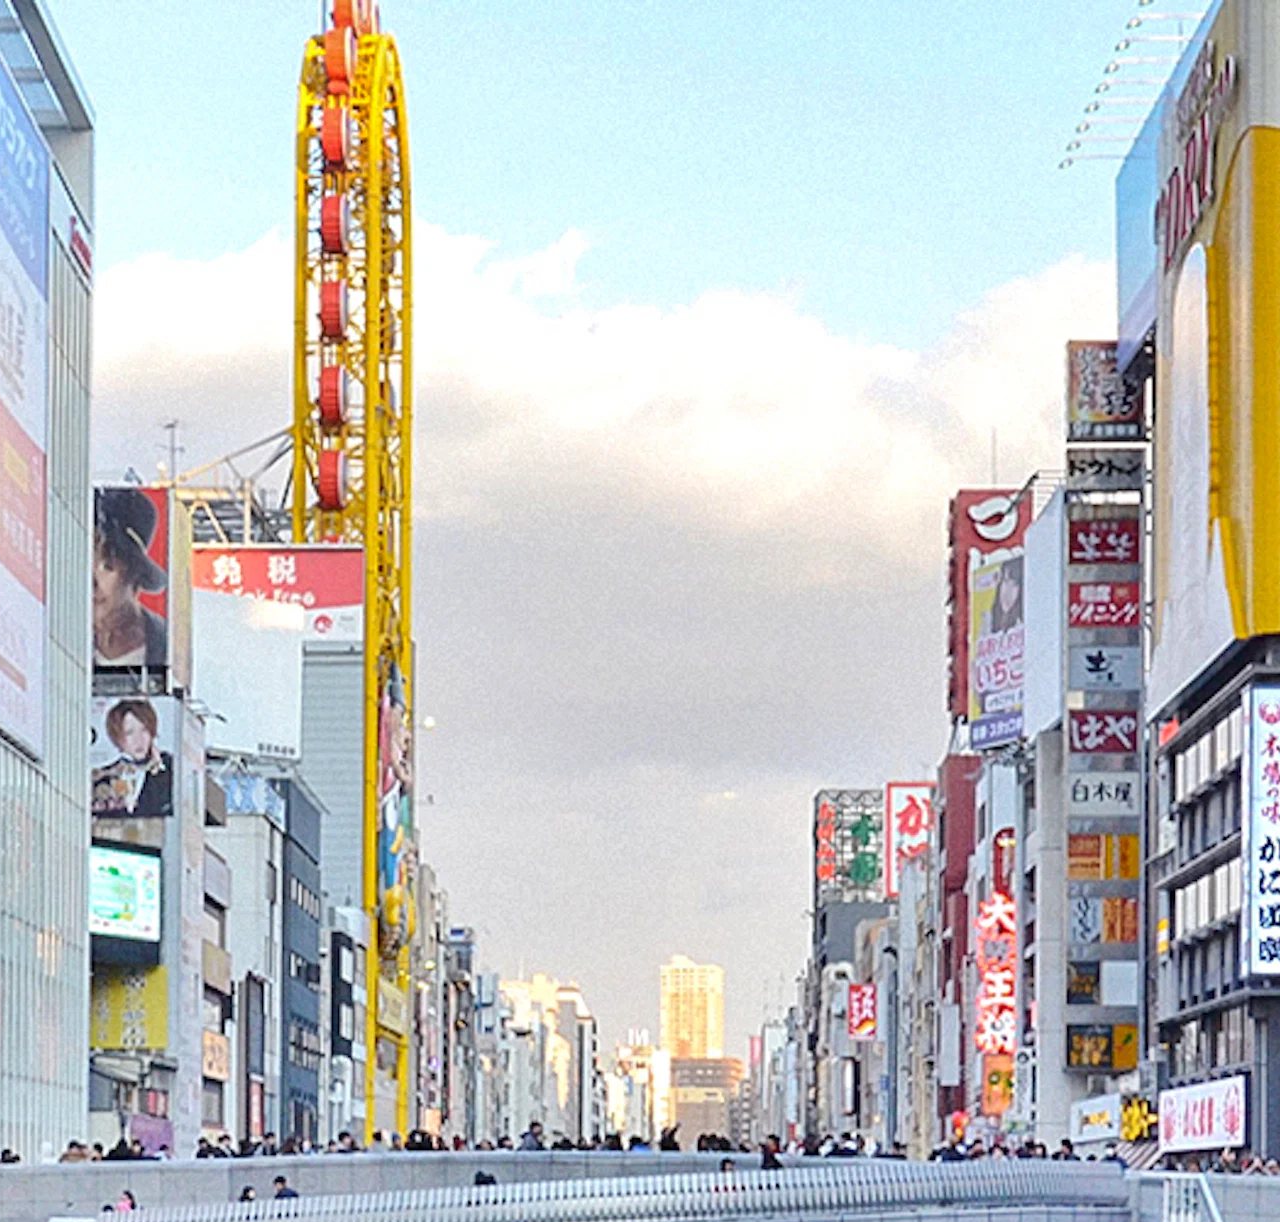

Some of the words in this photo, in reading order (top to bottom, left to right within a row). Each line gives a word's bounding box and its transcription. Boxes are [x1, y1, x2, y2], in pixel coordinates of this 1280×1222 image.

[212, 553, 297, 586] 免税
[1071, 779, 1134, 802] 白木屋
